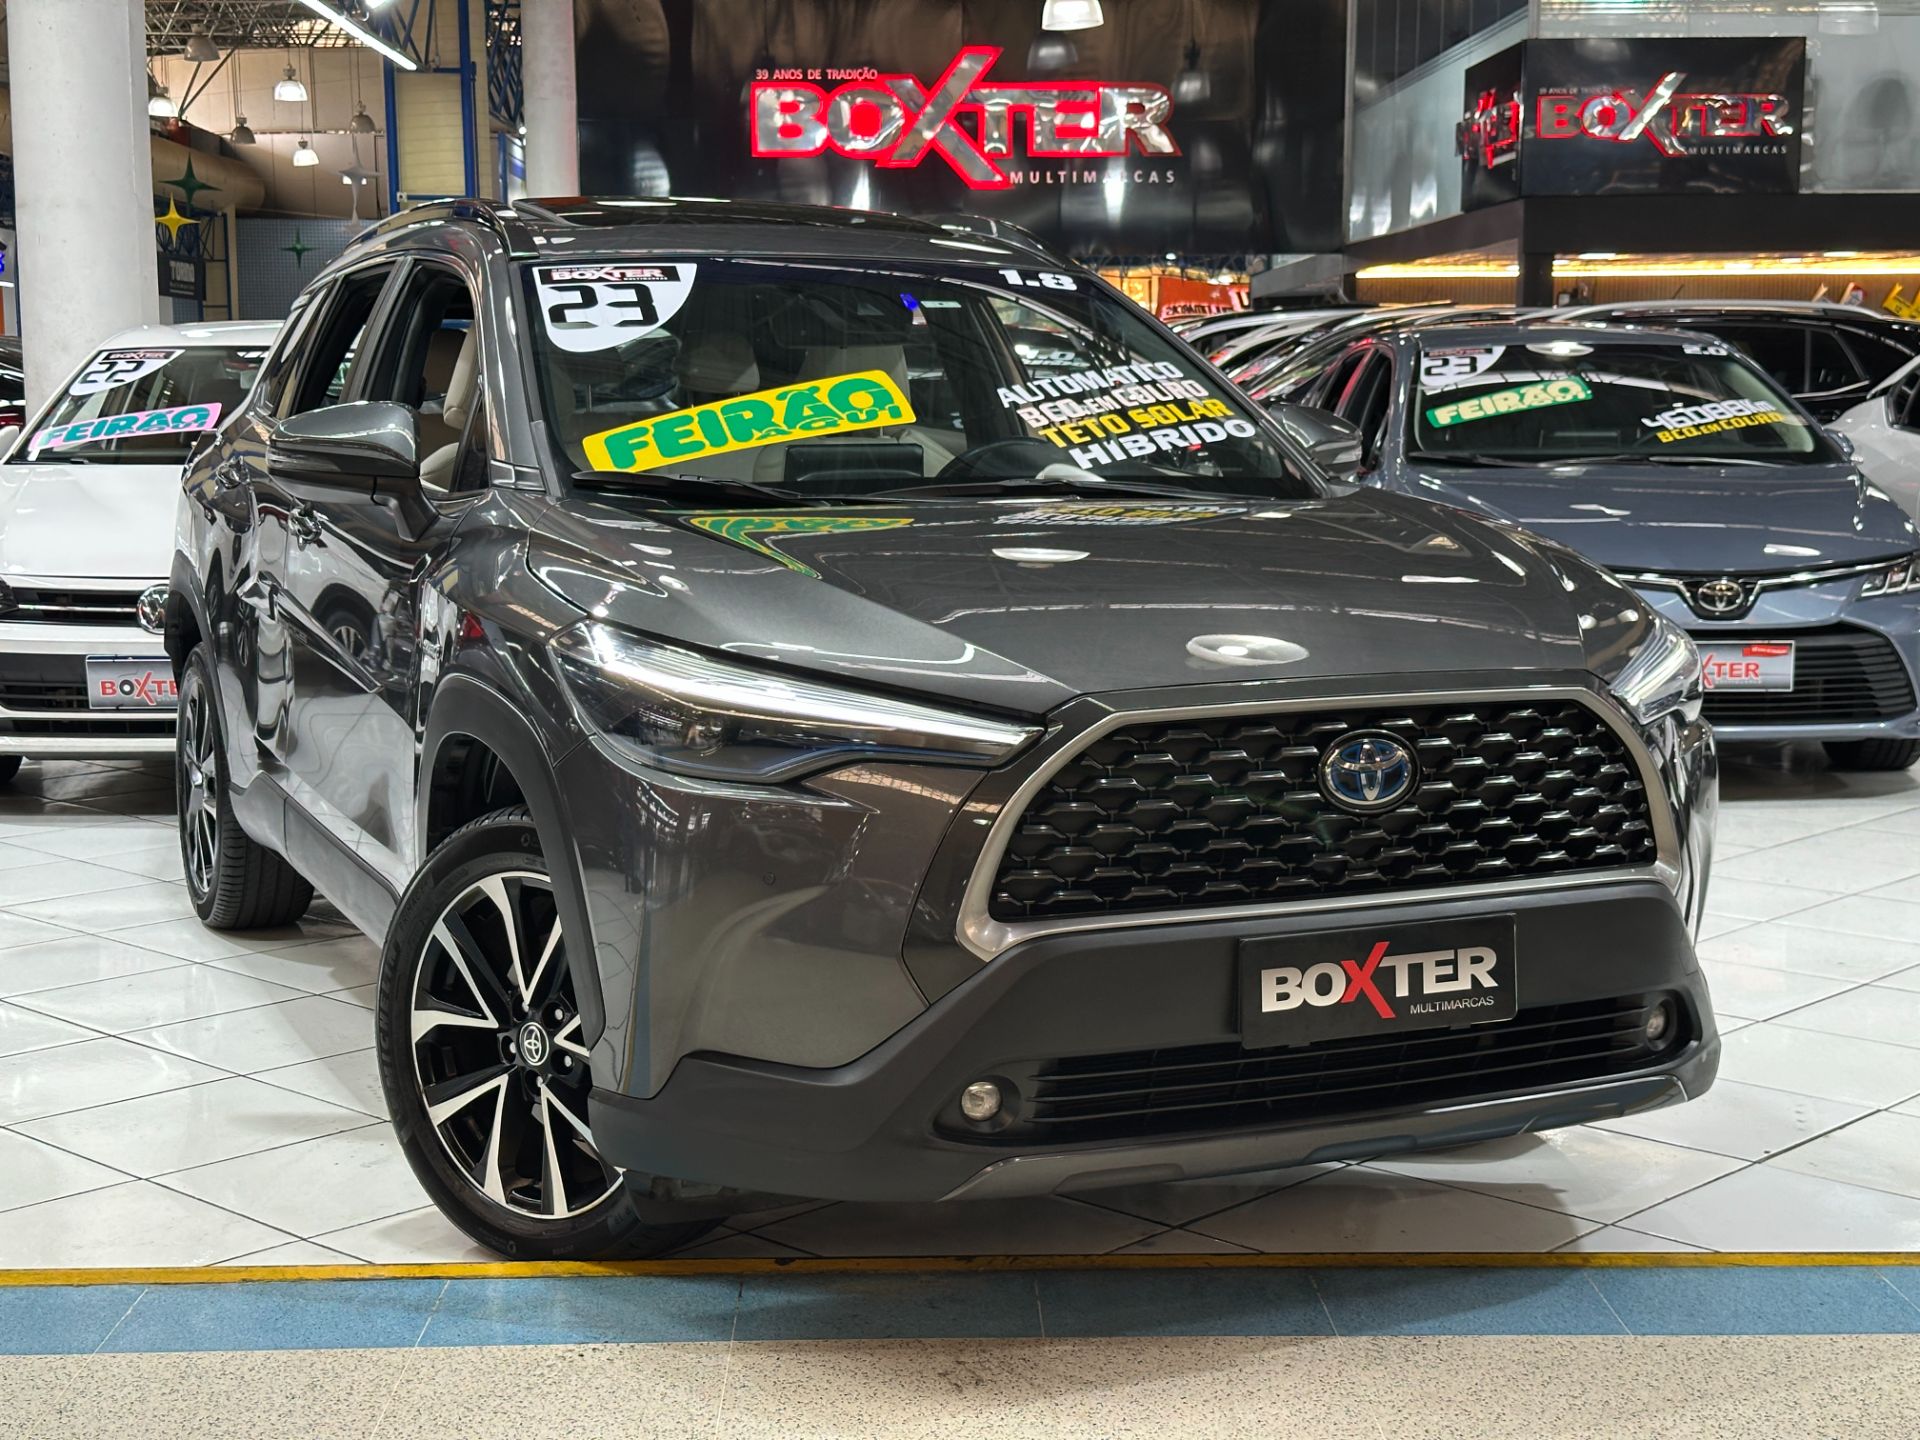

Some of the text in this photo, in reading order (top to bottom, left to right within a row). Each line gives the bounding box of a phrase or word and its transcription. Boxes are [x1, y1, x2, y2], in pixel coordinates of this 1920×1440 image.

[755, 67, 878, 81] 39 ANOS DE TRADIÇÃO
[751, 46, 1182, 190] BOXTER
[1537, 72, 1794, 158] BOXTER
[1687, 145, 1787, 156] MULTIMARCAS
[1009, 170, 1175, 184] MULTIMARCAS
[551, 266, 666, 281] BOXTER
[998, 269, 1078, 291] 1.8
[547, 283, 660, 330] 23
[79, 360, 146, 385] 22
[1424, 356, 1478, 376] 23
[1110, 379, 1210, 407] COURO
[1433, 380, 1582, 425] FEIRÃO
[603, 378, 895, 470] FEIRÃO
[1038, 398, 1235, 448] TETO SOLAR
[1260, 941, 1499, 1019] BOXTER
[1409, 995, 1495, 1014] MULTIMARCAS
